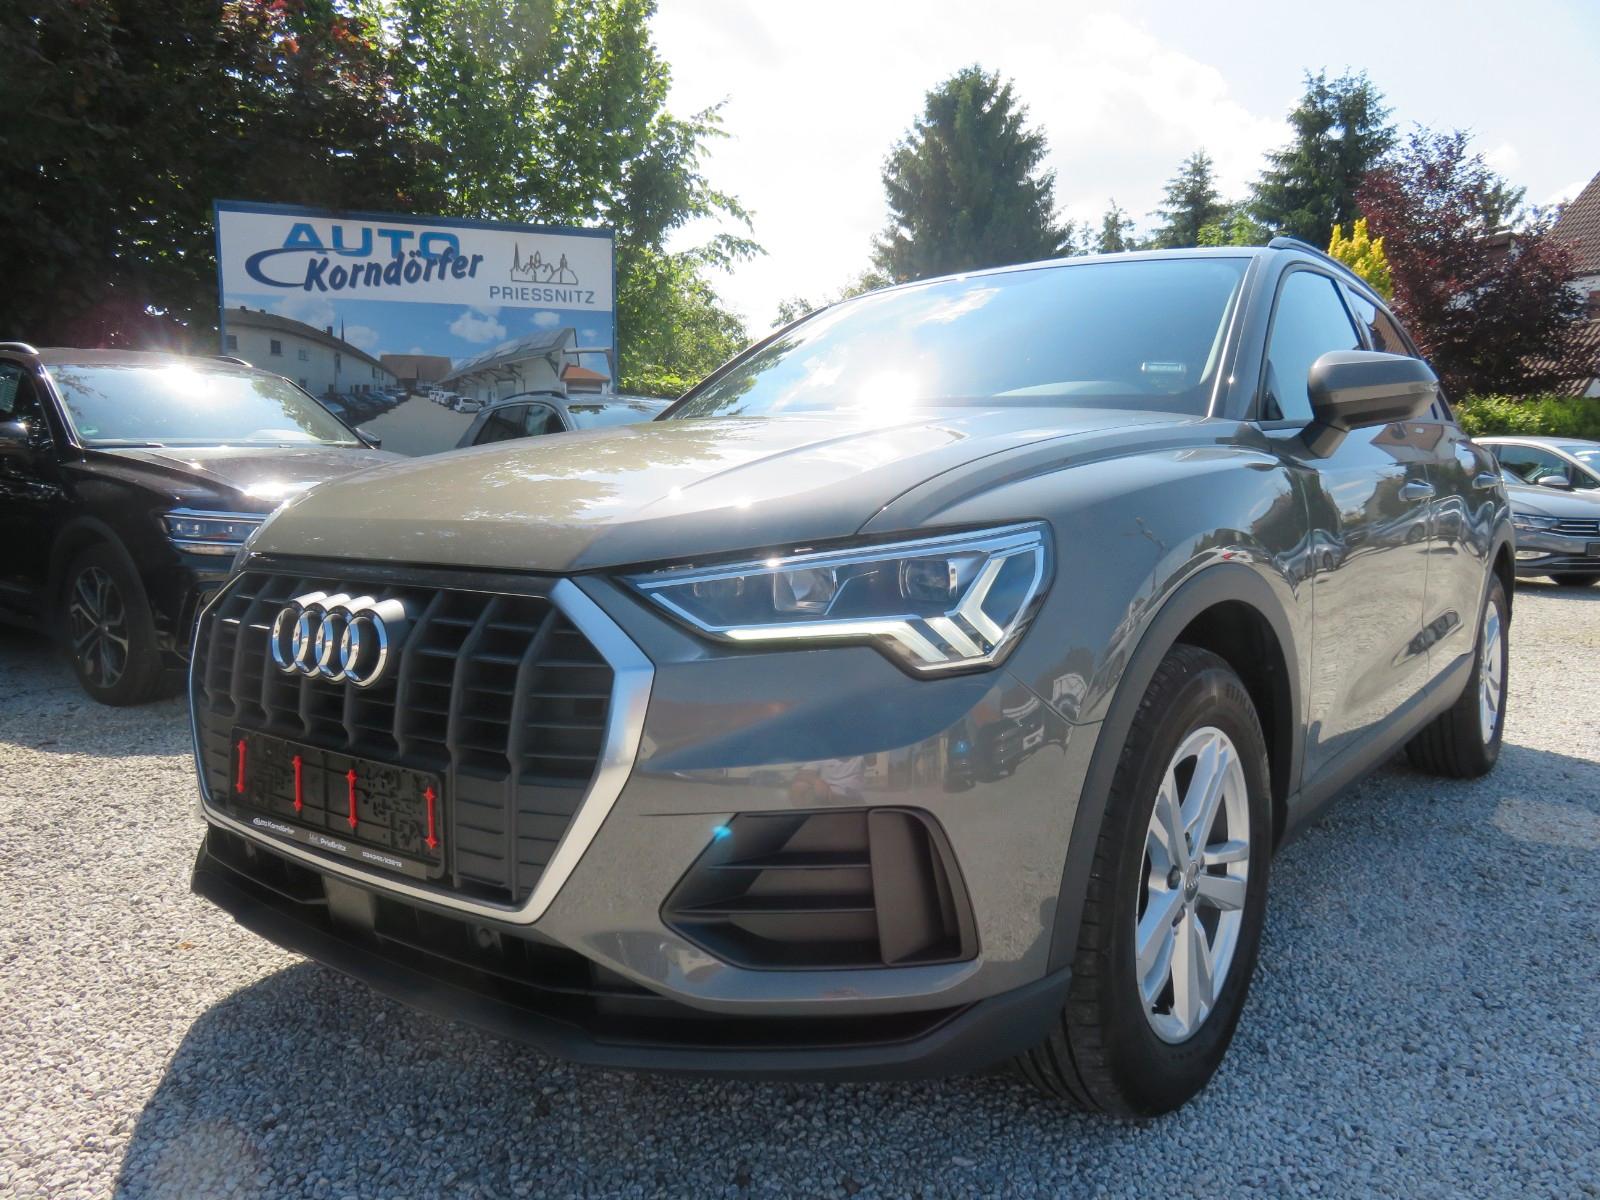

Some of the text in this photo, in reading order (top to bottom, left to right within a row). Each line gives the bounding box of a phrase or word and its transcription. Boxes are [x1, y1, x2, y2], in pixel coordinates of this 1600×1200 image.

[282, 223, 461, 258] AUTO
[303, 246, 484, 292] Korndörfer
[489, 286, 595, 304] PRIESSNITZ
